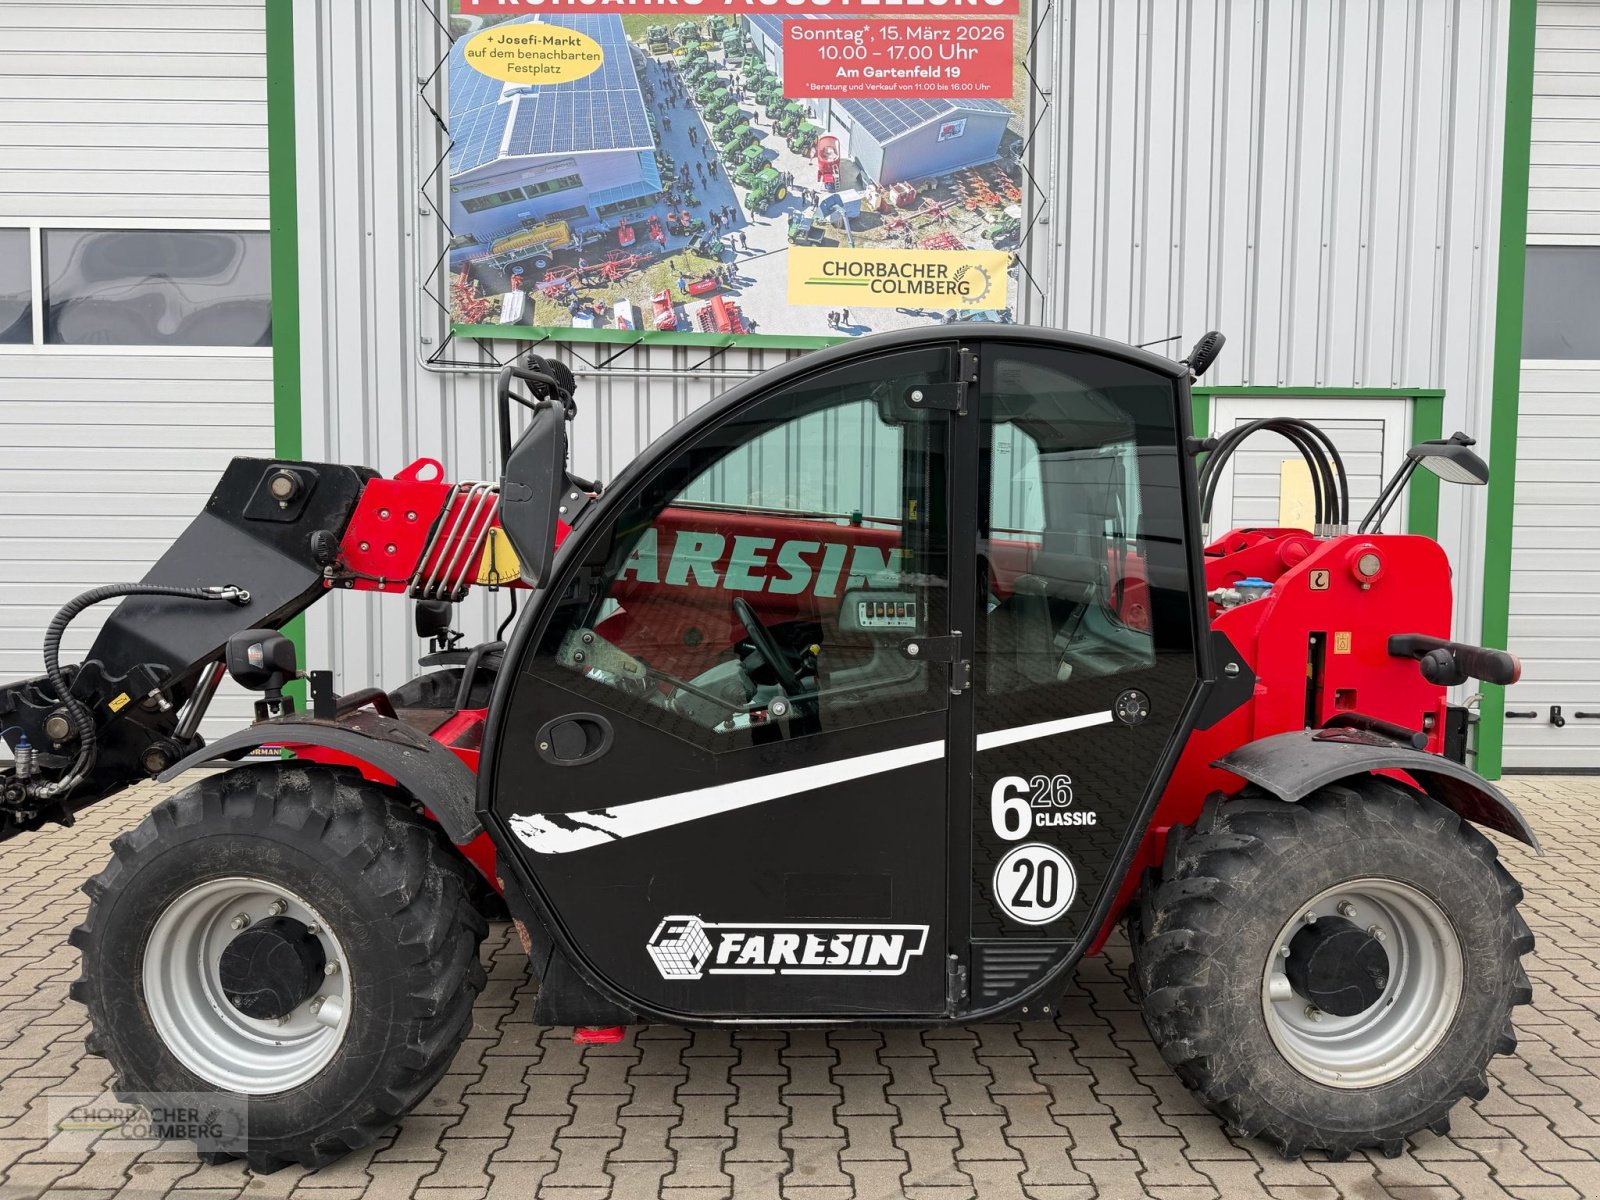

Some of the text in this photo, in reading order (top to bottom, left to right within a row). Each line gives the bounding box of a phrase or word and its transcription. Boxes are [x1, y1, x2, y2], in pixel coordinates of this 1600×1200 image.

[497, 34, 582, 46] Josefi-Markt
[879, 26, 903, 40] 15.
[906, 26, 951, 40] März
[956, 26, 1005, 40] 2026
[467, 48, 601, 61] auf dem benachbarten
[818, 45, 867, 60] 10.00
[886, 45, 933, 60] 17.00
[939, 42, 979, 60] Uhr
[507, 62, 562, 76] Festplatz
[835, 65, 961, 78] Am Gartenfeld 19
[849, 83, 864, 91] und
[865, 83, 897, 91] Verkauf
[914, 83, 936, 91] 11.00
[937, 83, 949, 91] bis
[951, 83, 973, 91] 16.00
[975, 83, 991, 91] Uhr
[822, 261, 948, 279] CHORBACHER
[870, 279, 970, 296] COLMBERG
[1035, 811, 1097, 827] CLASSIC
[1011, 857, 1059, 909] 20
[716, 933, 905, 966] FARESIN
